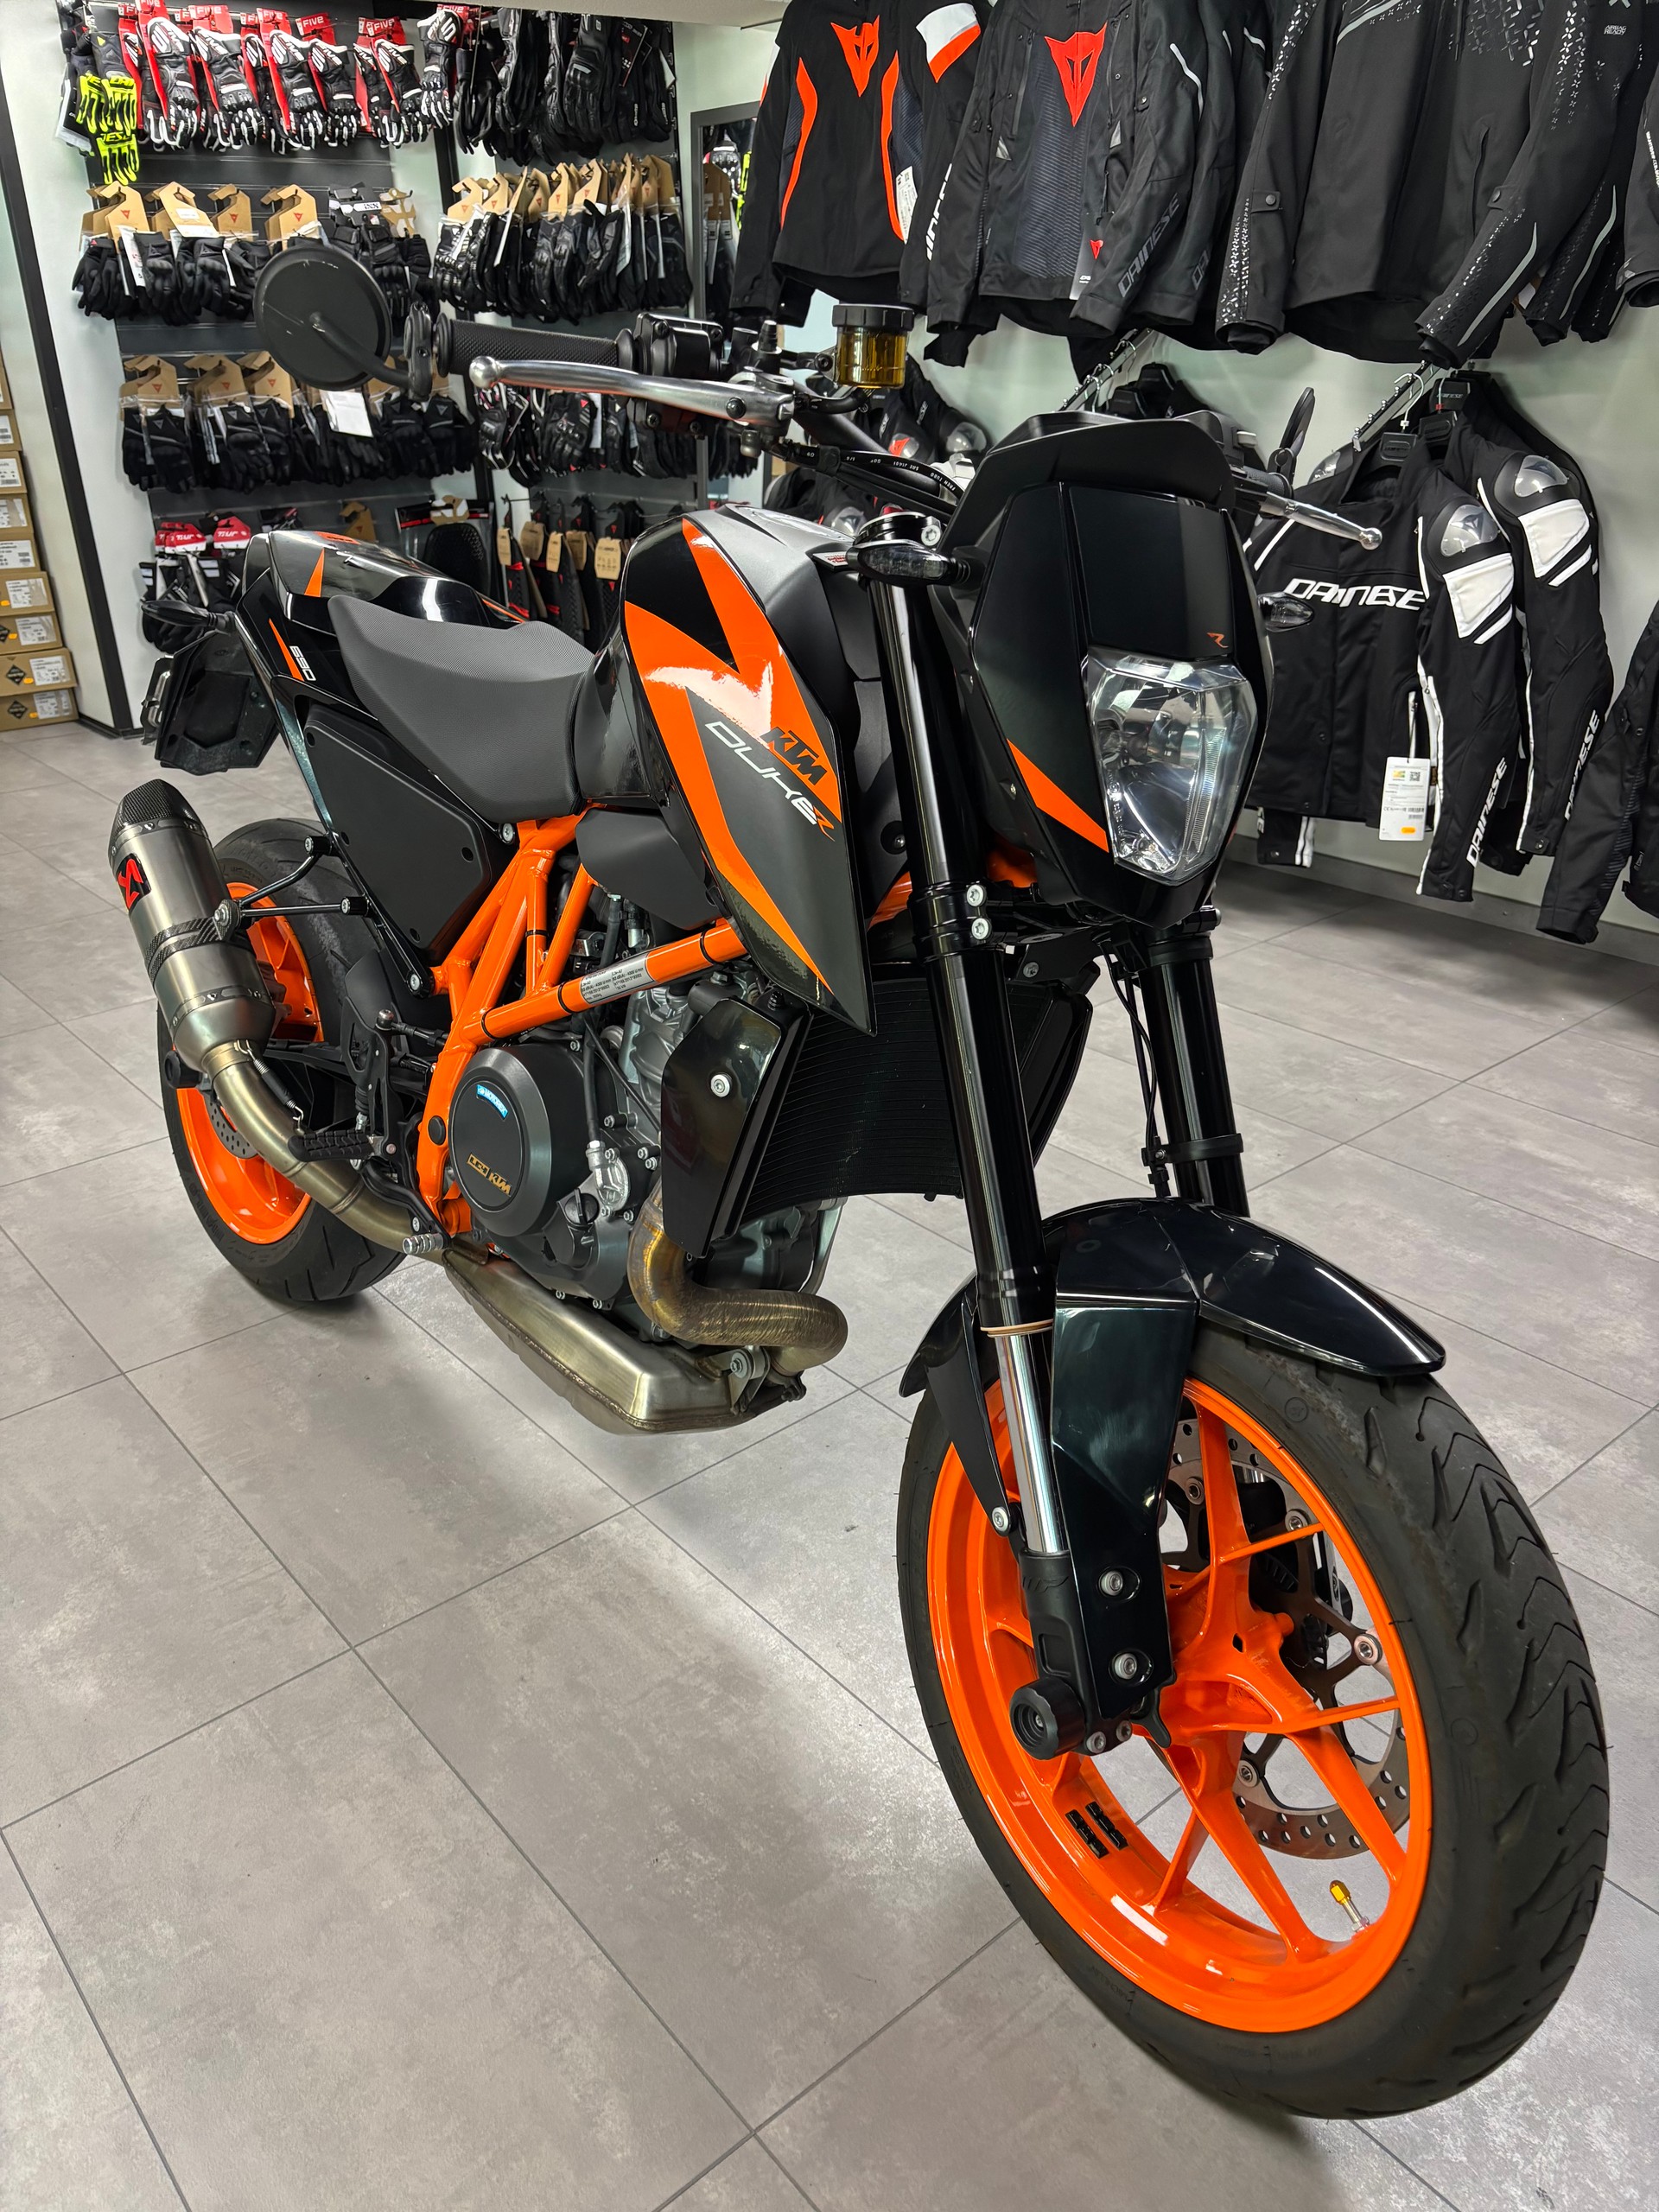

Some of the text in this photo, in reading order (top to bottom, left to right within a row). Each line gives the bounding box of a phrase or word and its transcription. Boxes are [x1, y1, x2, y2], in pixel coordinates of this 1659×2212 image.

[303, 16, 324, 27] FIVE
[373, 19, 395, 31] FIVE
[1117, 193, 1179, 298] DAINESE
[1283, 578, 1426, 611] DAINESE
[289, 645, 316, 681] 690
[704, 721, 817, 825] DUKE
[760, 726, 828, 786] KTM
[1466, 757, 1508, 868] DAINESE
[489, 1172, 512, 1196] KTM
